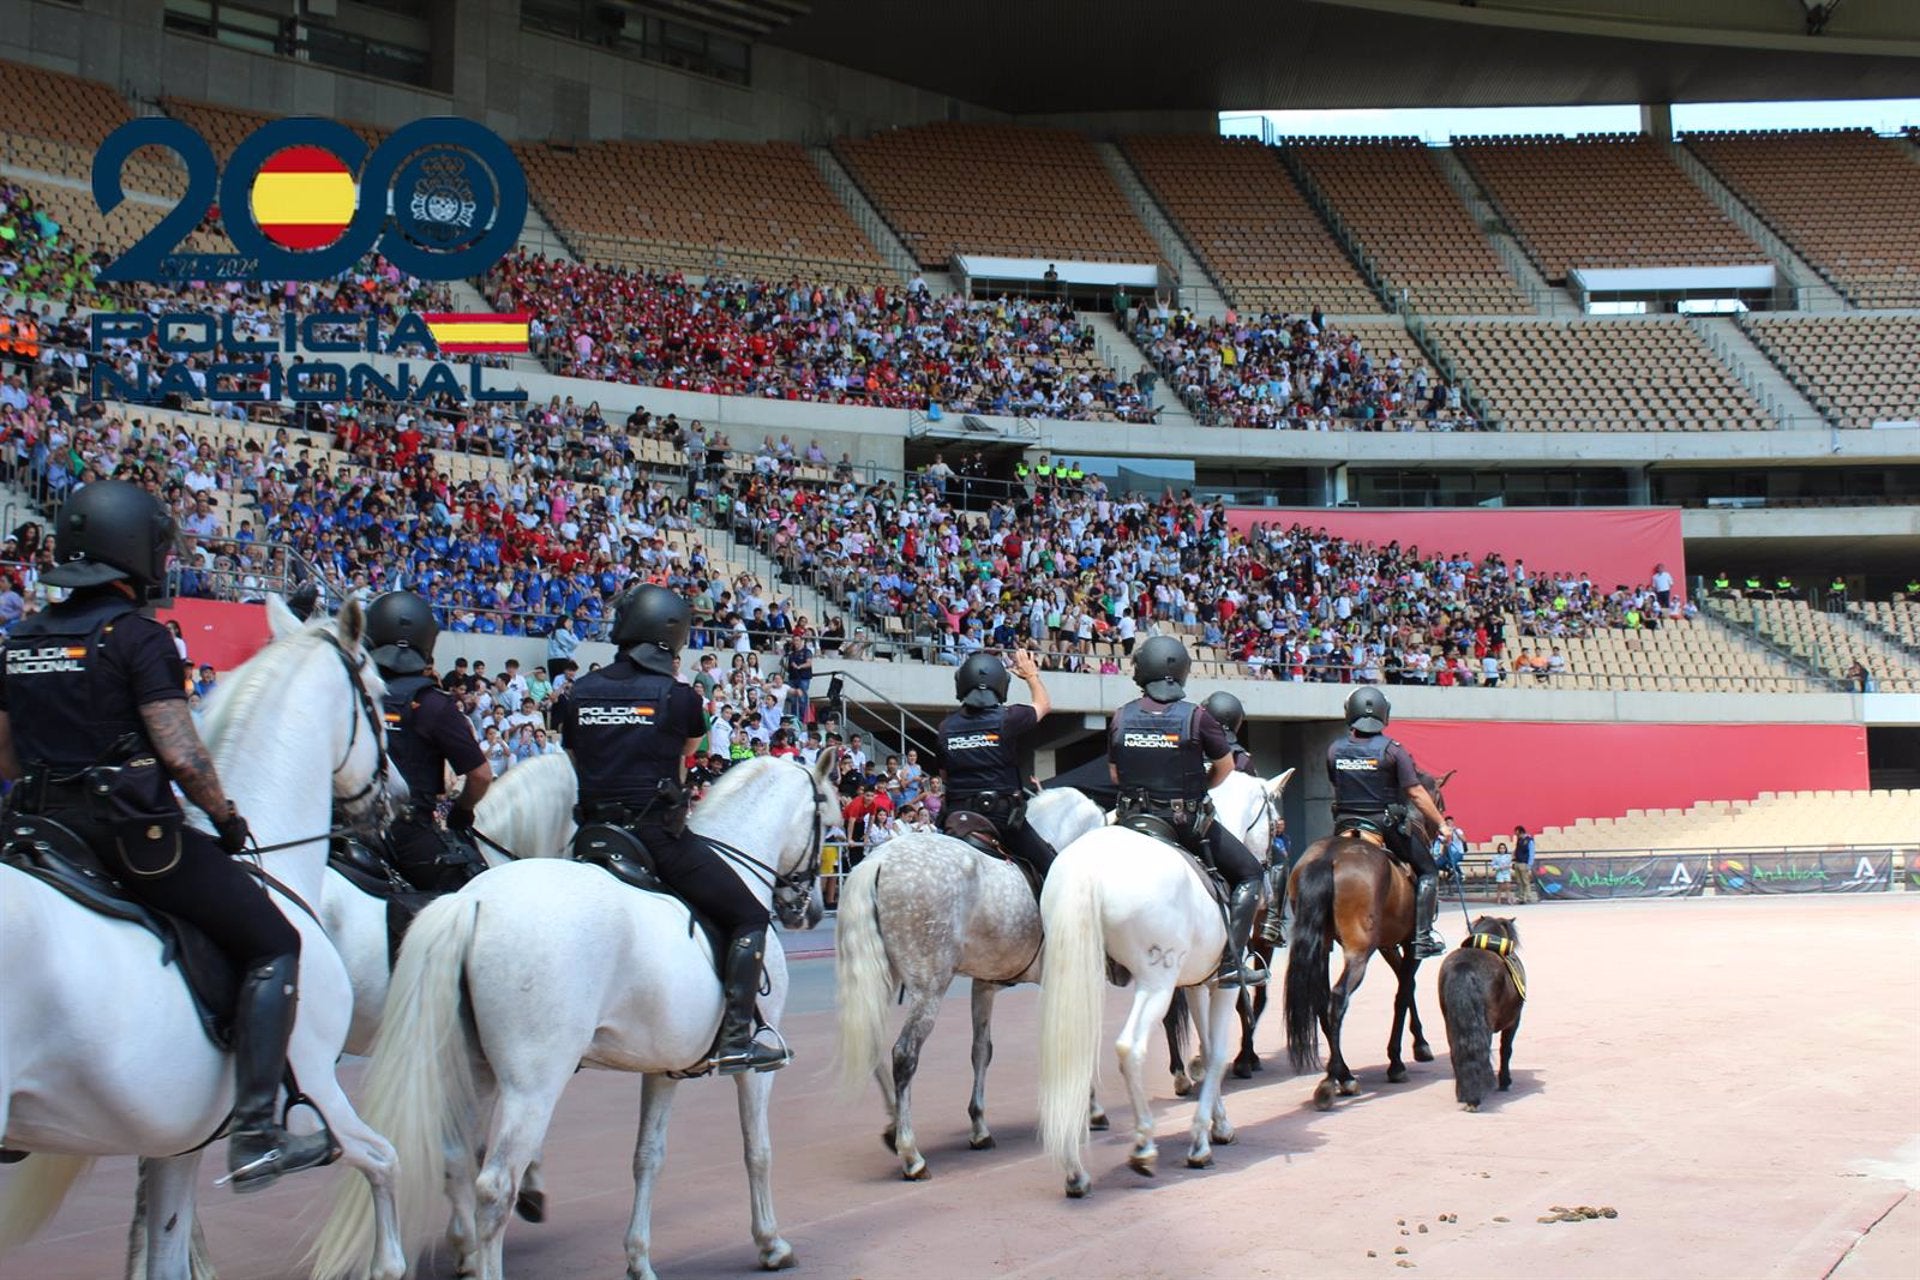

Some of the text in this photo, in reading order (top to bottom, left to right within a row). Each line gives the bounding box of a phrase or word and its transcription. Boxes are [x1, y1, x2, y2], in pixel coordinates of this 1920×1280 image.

[6, 647, 70, 661] POLICIA
[6, 660, 85, 675] NACIONAL
[578, 706, 640, 716] POLICIA
[578, 715, 654, 726] NACIONAL
[947, 734, 988, 745] POLICIA
[1124, 733, 1168, 741] POLICIA
[947, 740, 1000, 751] NACIONAL
[1124, 740, 1179, 749] NACIONAL
